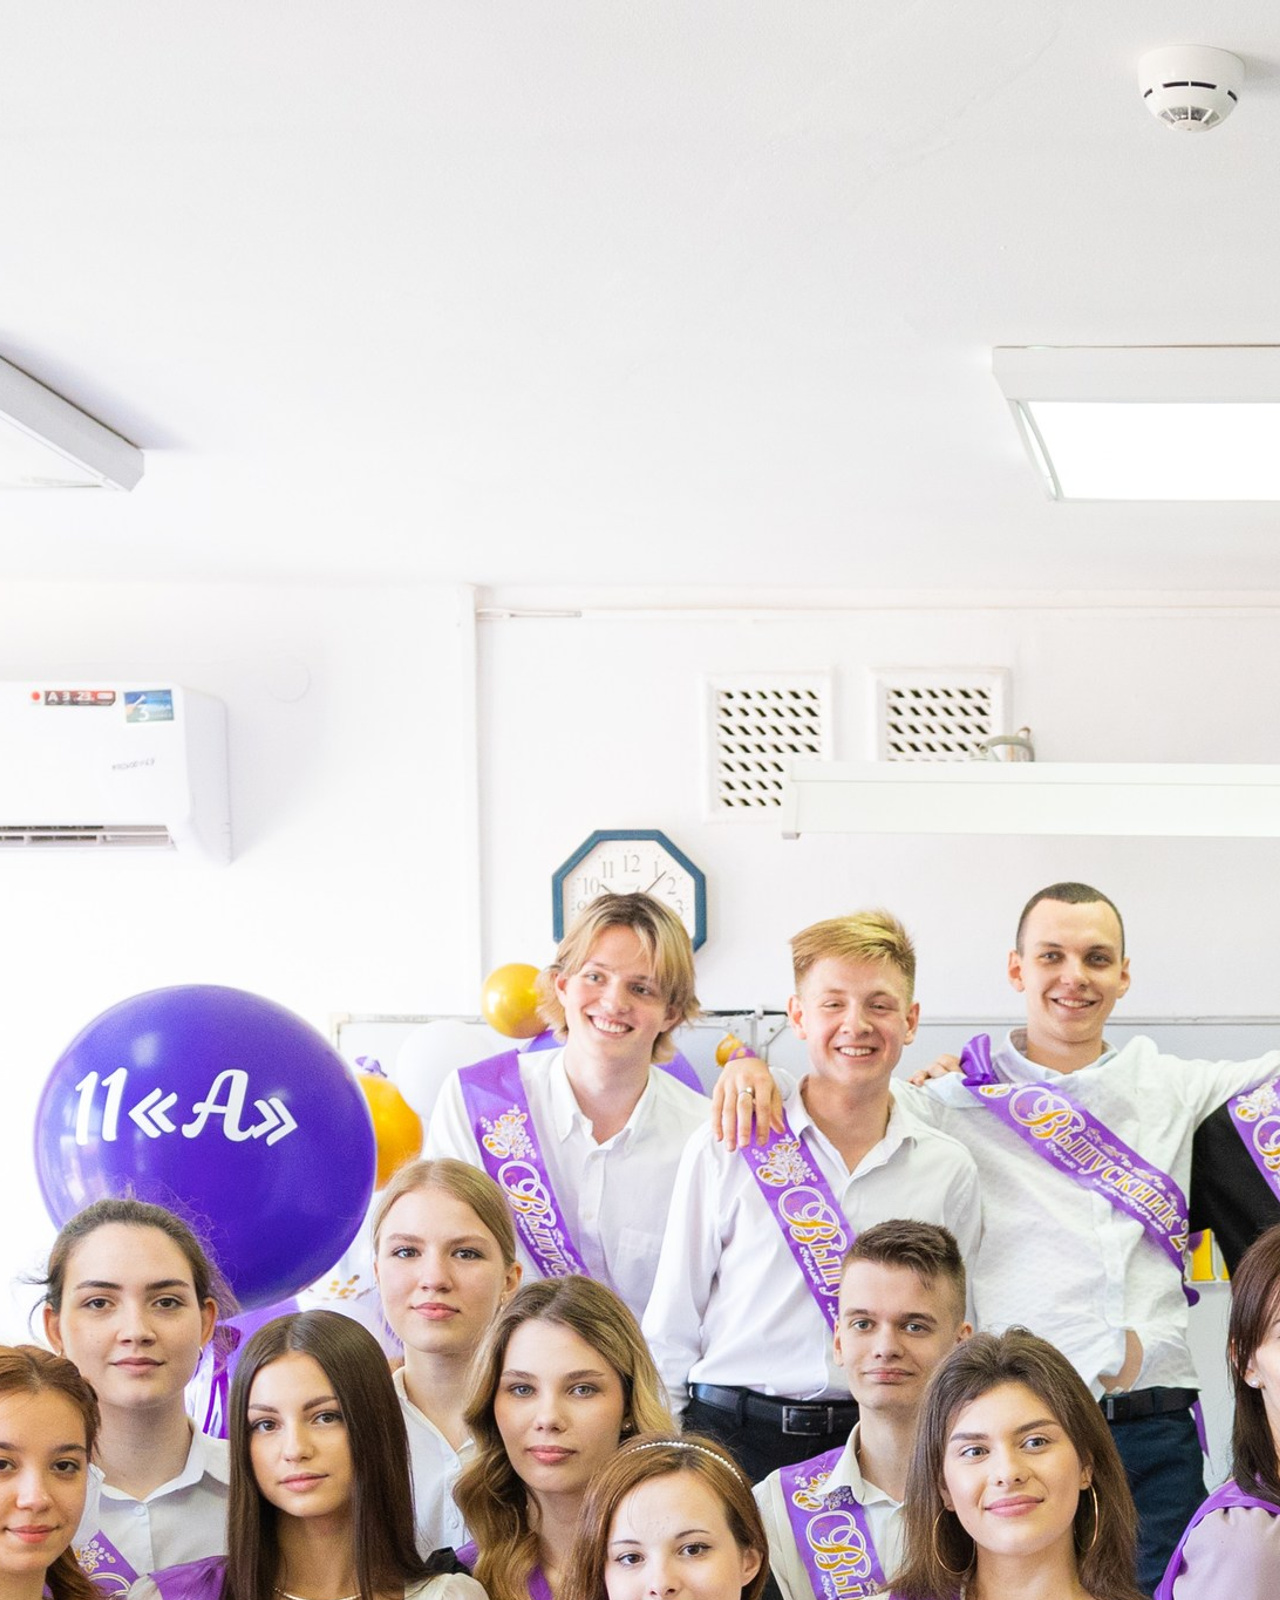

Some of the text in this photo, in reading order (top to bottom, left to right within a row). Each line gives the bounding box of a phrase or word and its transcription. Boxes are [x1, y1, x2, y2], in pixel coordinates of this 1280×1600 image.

[602, 861, 614, 879] 11
[623, 855, 640, 873] 12
[654, 861, 660, 878] 1
[583, 877, 601, 895] 10
[666, 877, 677, 895] 2
